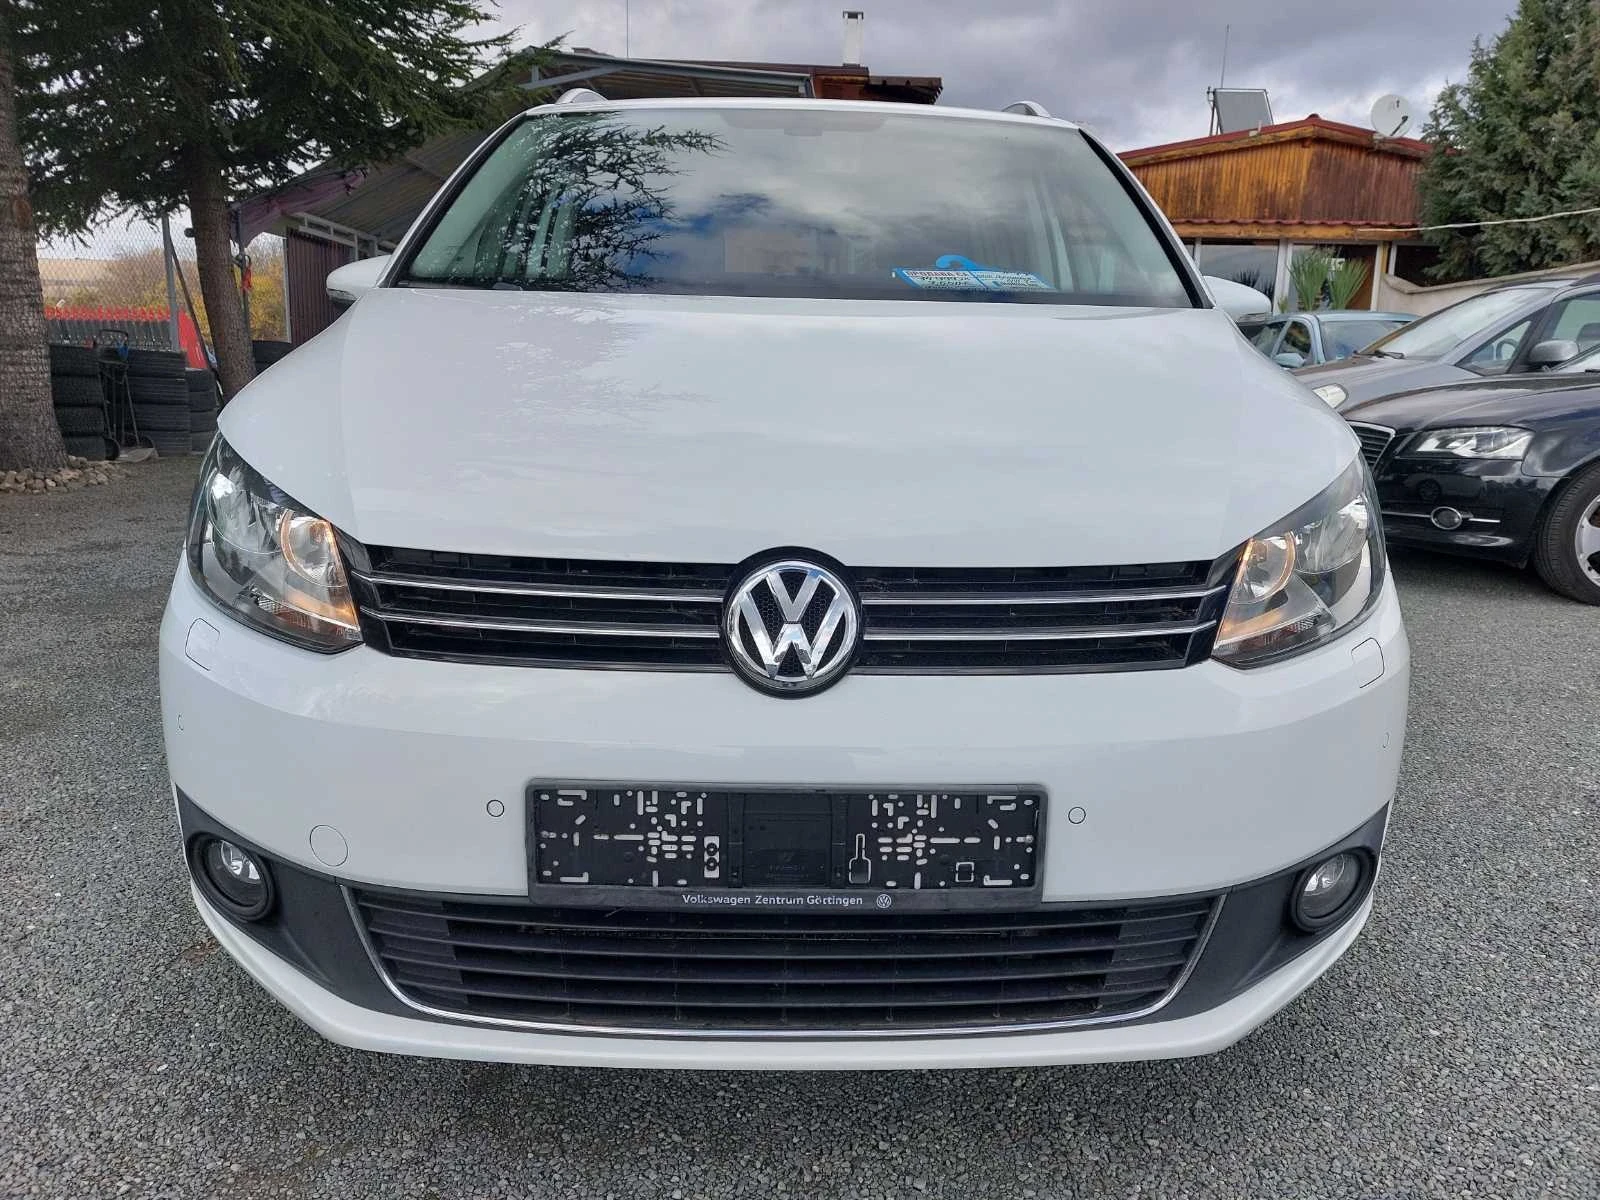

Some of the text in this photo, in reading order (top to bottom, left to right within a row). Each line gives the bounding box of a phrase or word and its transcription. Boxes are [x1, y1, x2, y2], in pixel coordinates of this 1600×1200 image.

[733, 563, 850, 681] VW
[681, 894, 751, 906] Volkswagen
[754, 895, 804, 905] Zentrum
